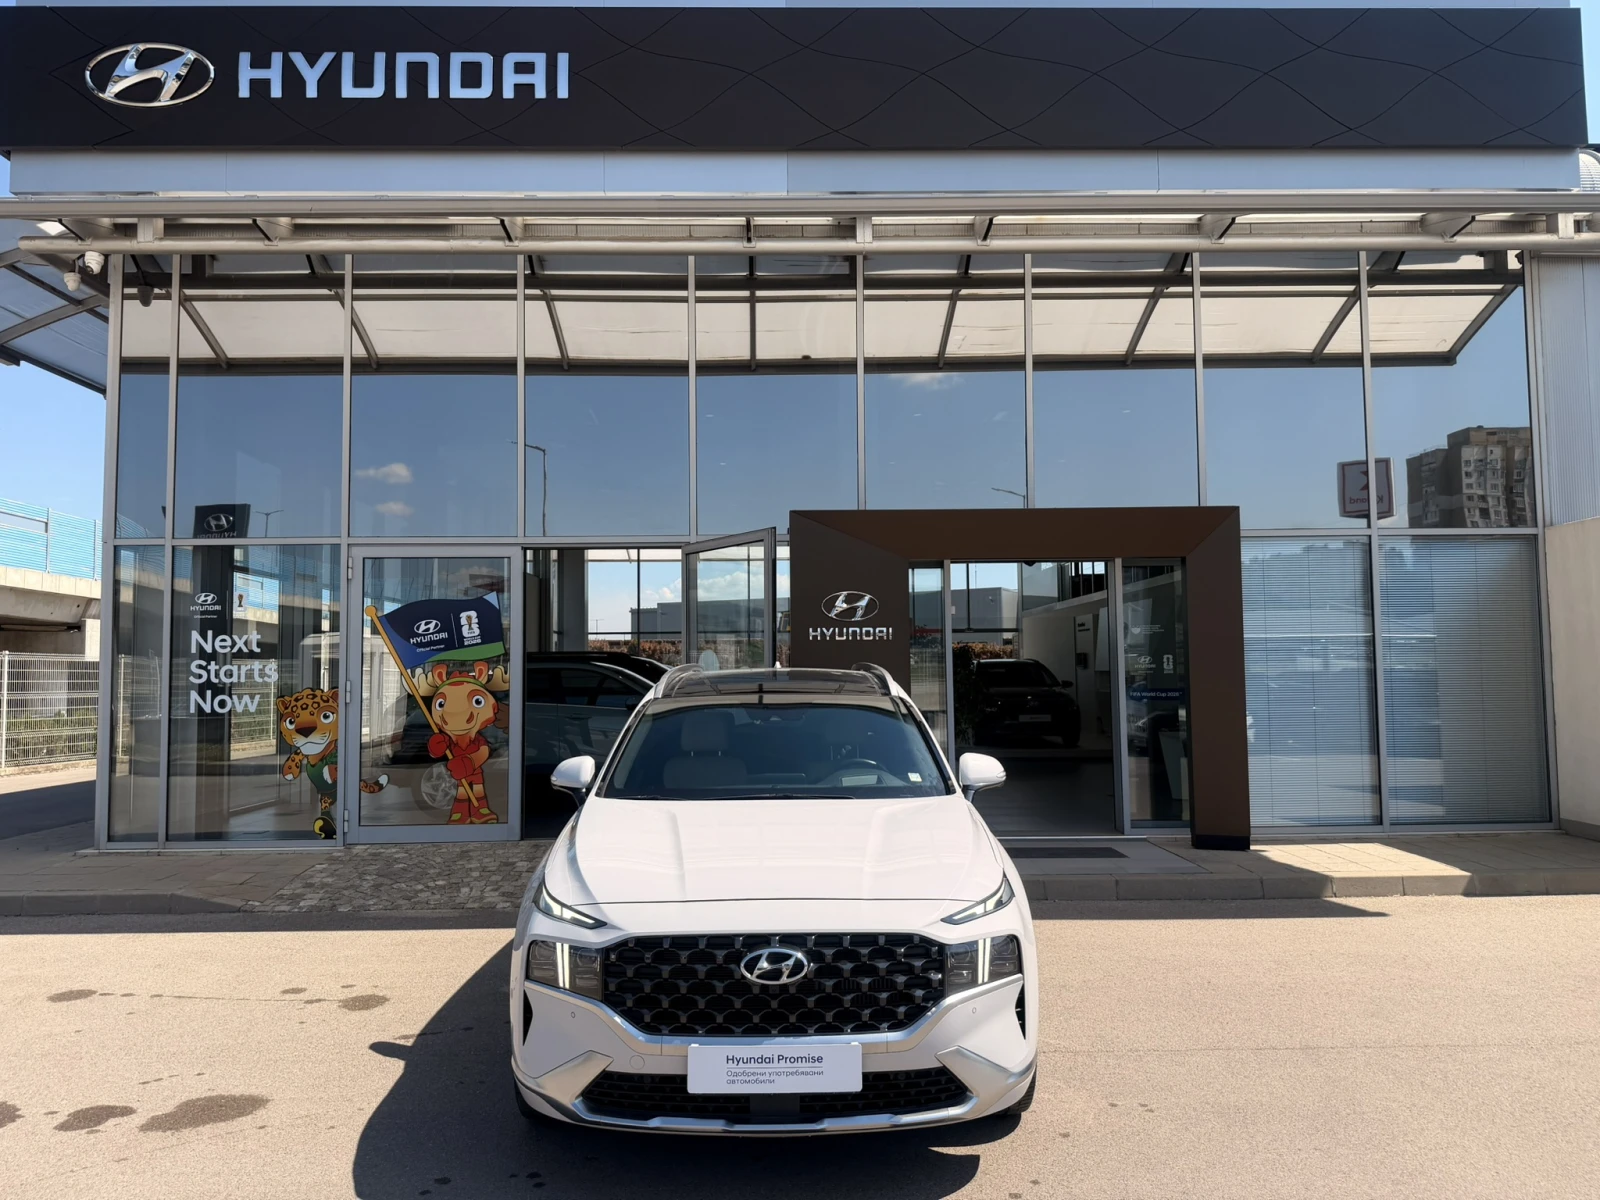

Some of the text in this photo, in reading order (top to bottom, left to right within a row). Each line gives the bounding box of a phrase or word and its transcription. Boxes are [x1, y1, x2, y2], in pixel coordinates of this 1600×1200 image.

[238, 51, 569, 99] HYUNDAI
[191, 630, 261, 653] Next
[410, 631, 448, 645] HYUNDAI
[809, 627, 893, 640] HYUNDAI
[188, 659, 279, 684] Starts
[189, 690, 260, 714] Now
[726, 1054, 823, 1066] Hyundai Promise
[726, 1069, 824, 1078] Одобрени употребявани
